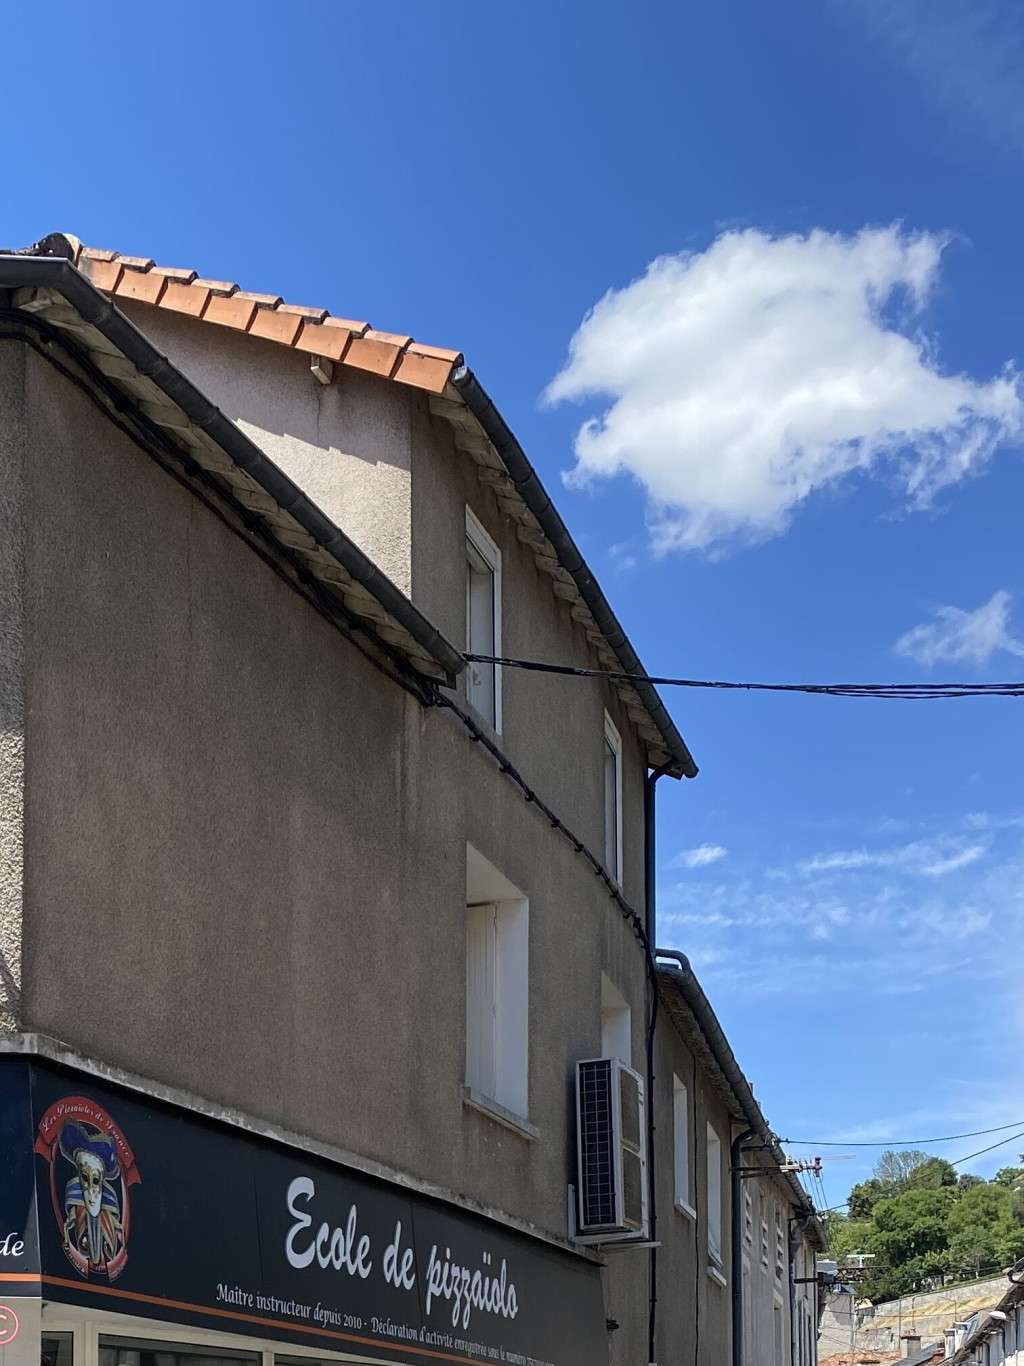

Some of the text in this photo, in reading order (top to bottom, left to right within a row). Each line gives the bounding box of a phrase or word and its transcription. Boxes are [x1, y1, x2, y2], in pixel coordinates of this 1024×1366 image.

[285, 1176, 519, 1330] Ecole de pizzaïolo
[216, 1283, 254, 1307] Maître
[256, 1291, 312, 1318] instructeur
[313, 1302, 342, 1328] depuis
[343, 1313, 362, 1330] 2010
[371, 1317, 418, 1341] Déclaration
